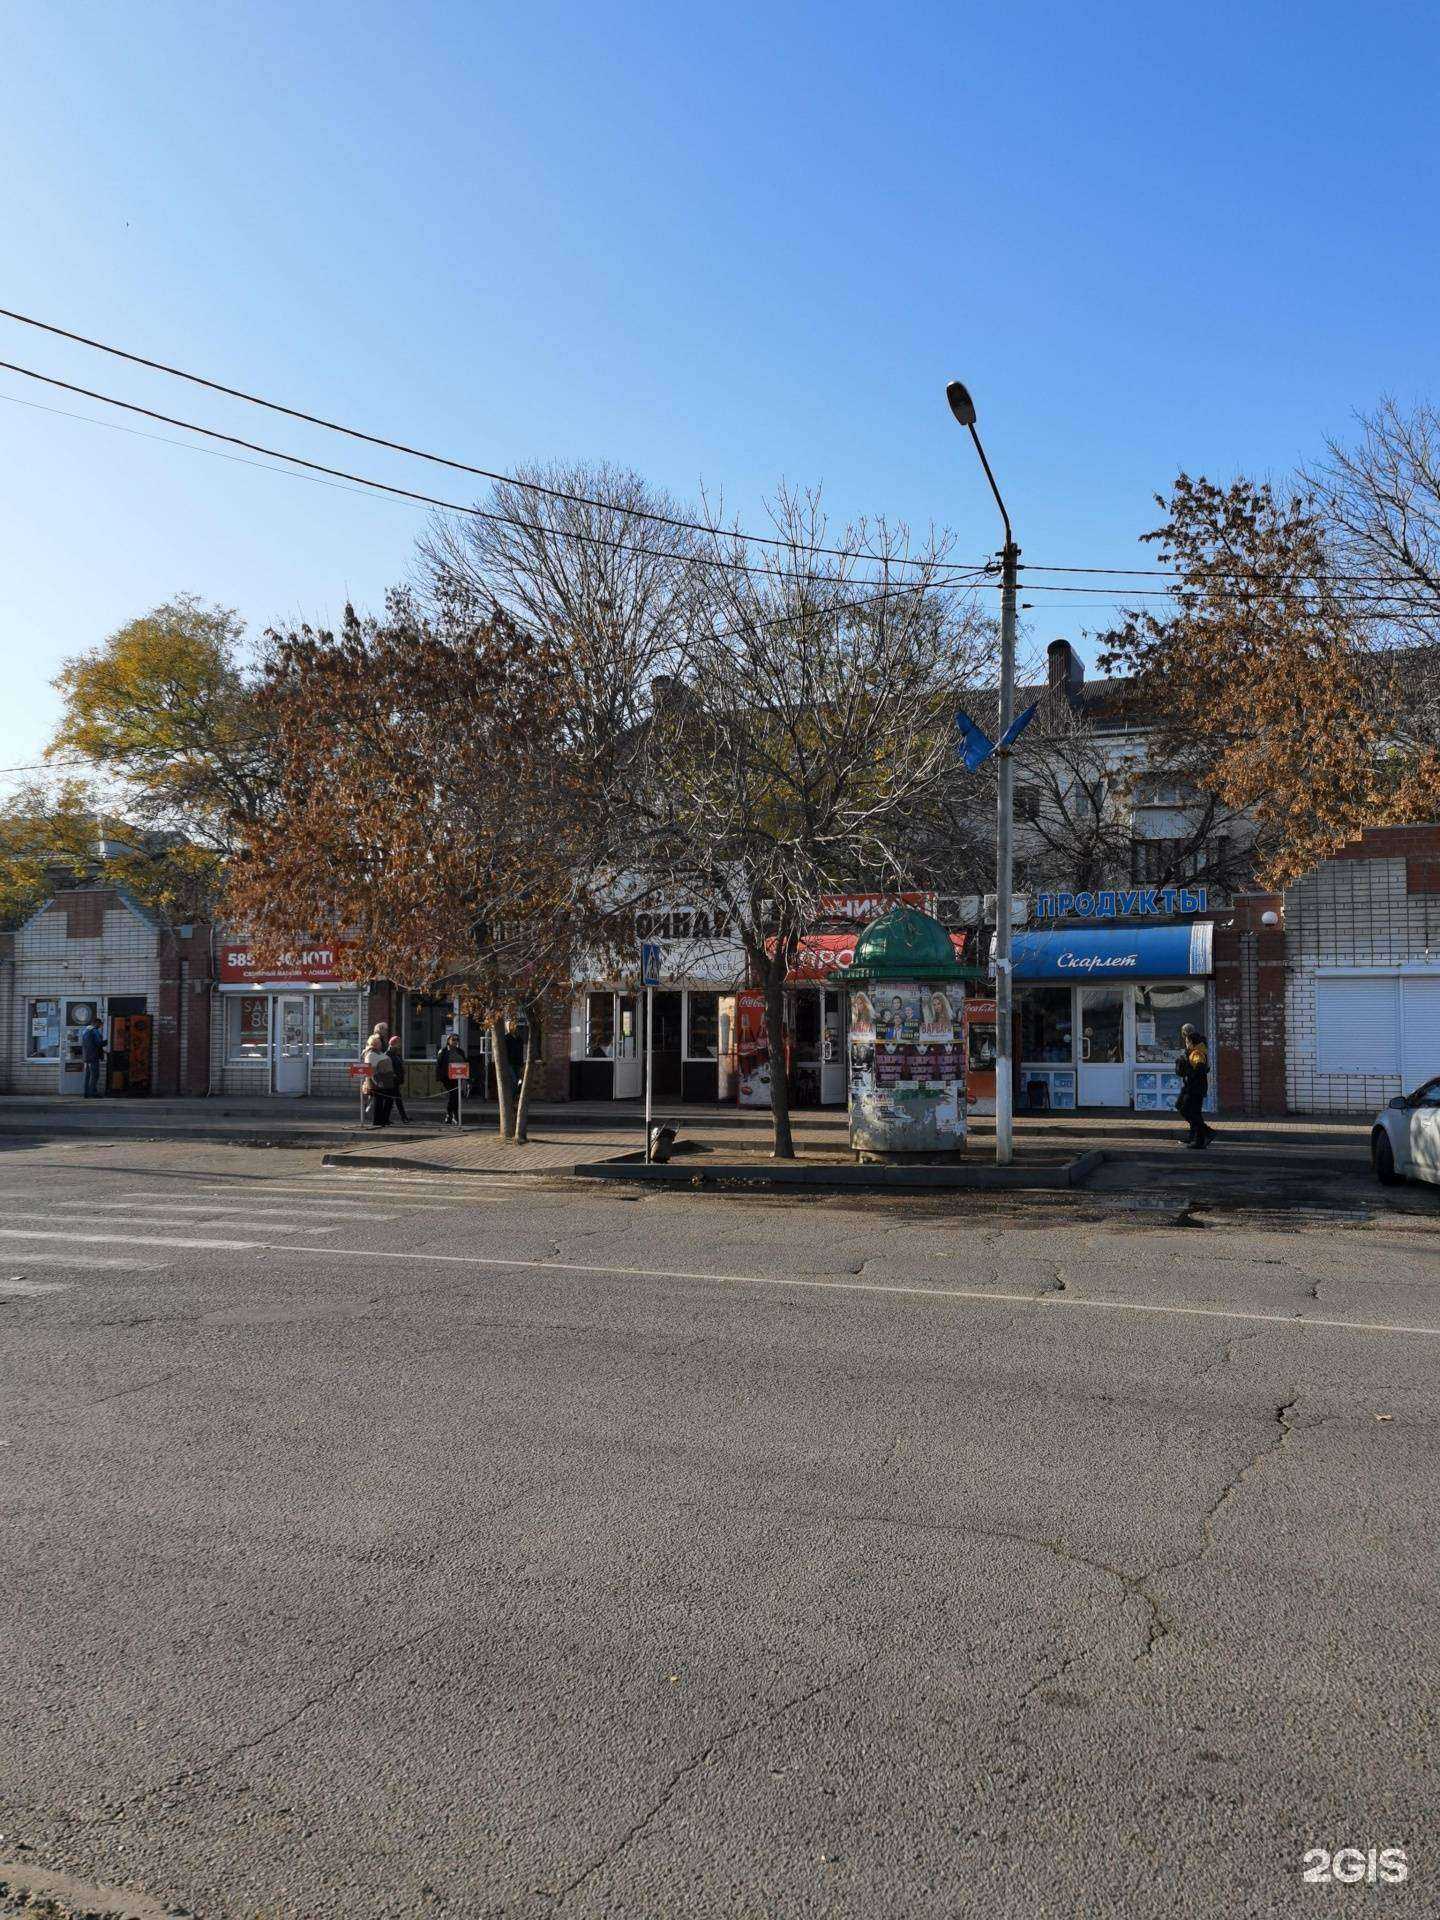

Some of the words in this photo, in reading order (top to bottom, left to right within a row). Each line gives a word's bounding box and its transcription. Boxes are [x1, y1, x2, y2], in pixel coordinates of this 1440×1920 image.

[1035, 887, 1208, 919] ПРОДУКТЫ
[227, 952, 256, 967] 585
[1056, 952, 1138, 972] Скарлет
